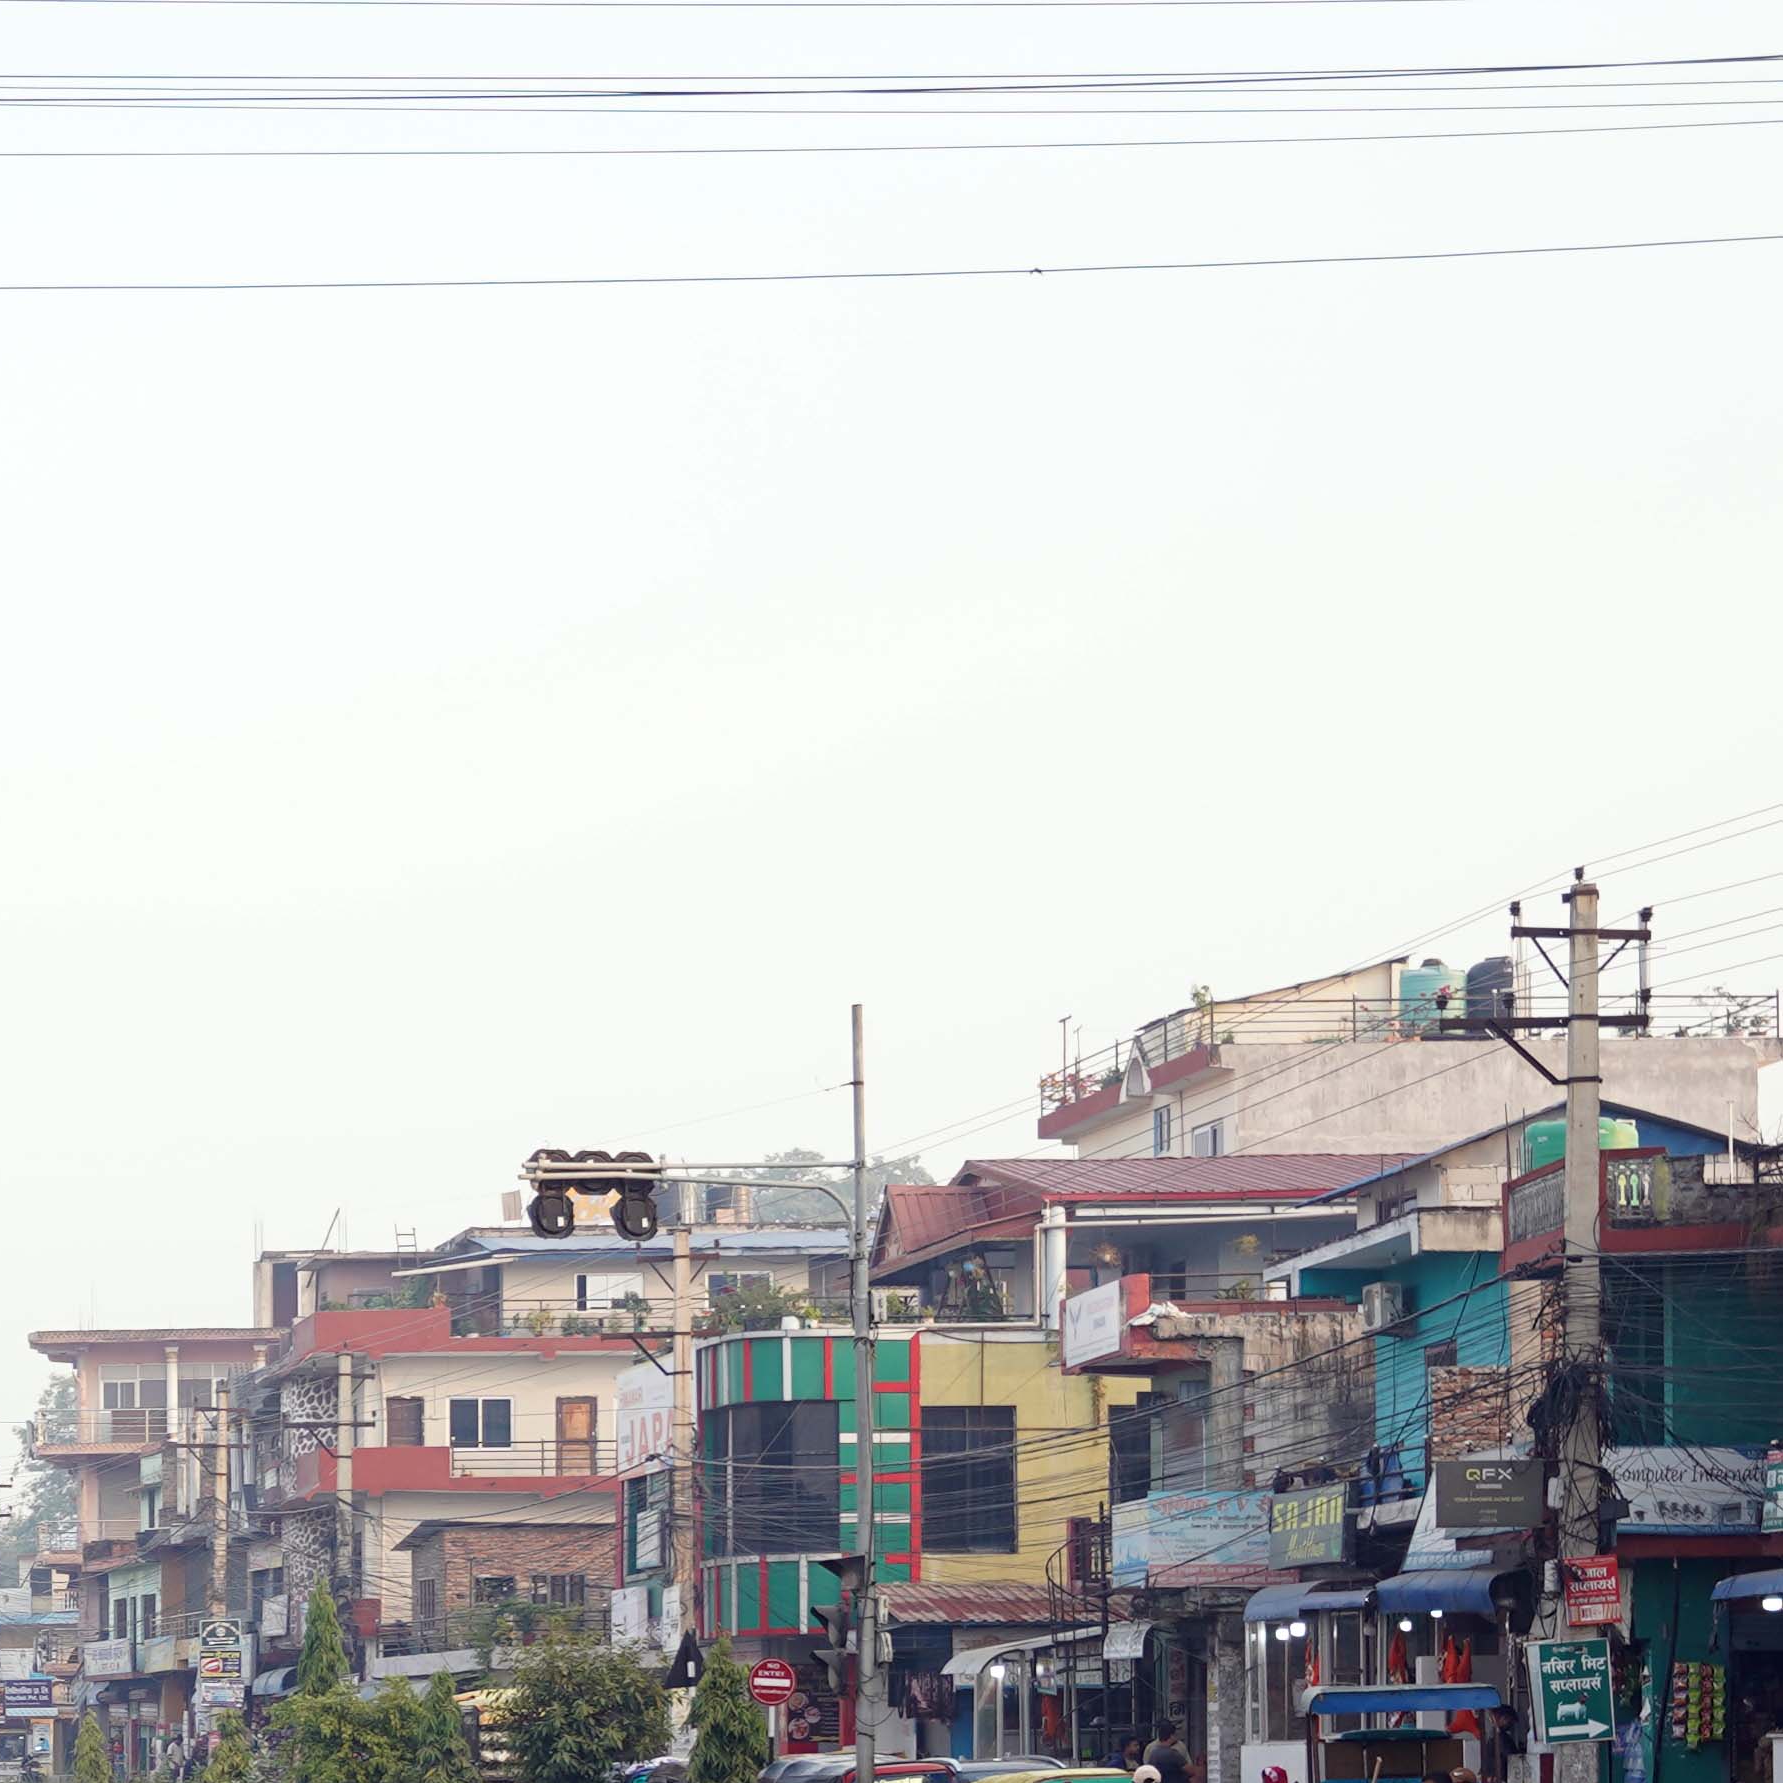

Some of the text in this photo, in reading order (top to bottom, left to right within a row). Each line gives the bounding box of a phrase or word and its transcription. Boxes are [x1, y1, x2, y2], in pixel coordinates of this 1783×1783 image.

[1466, 1468, 1513, 1480] QFX
[1613, 1462, 1766, 1489] Computer Internati
[1271, 1494, 1343, 1533] SAJAN
[1581, 1655, 1606, 1671] मिट
